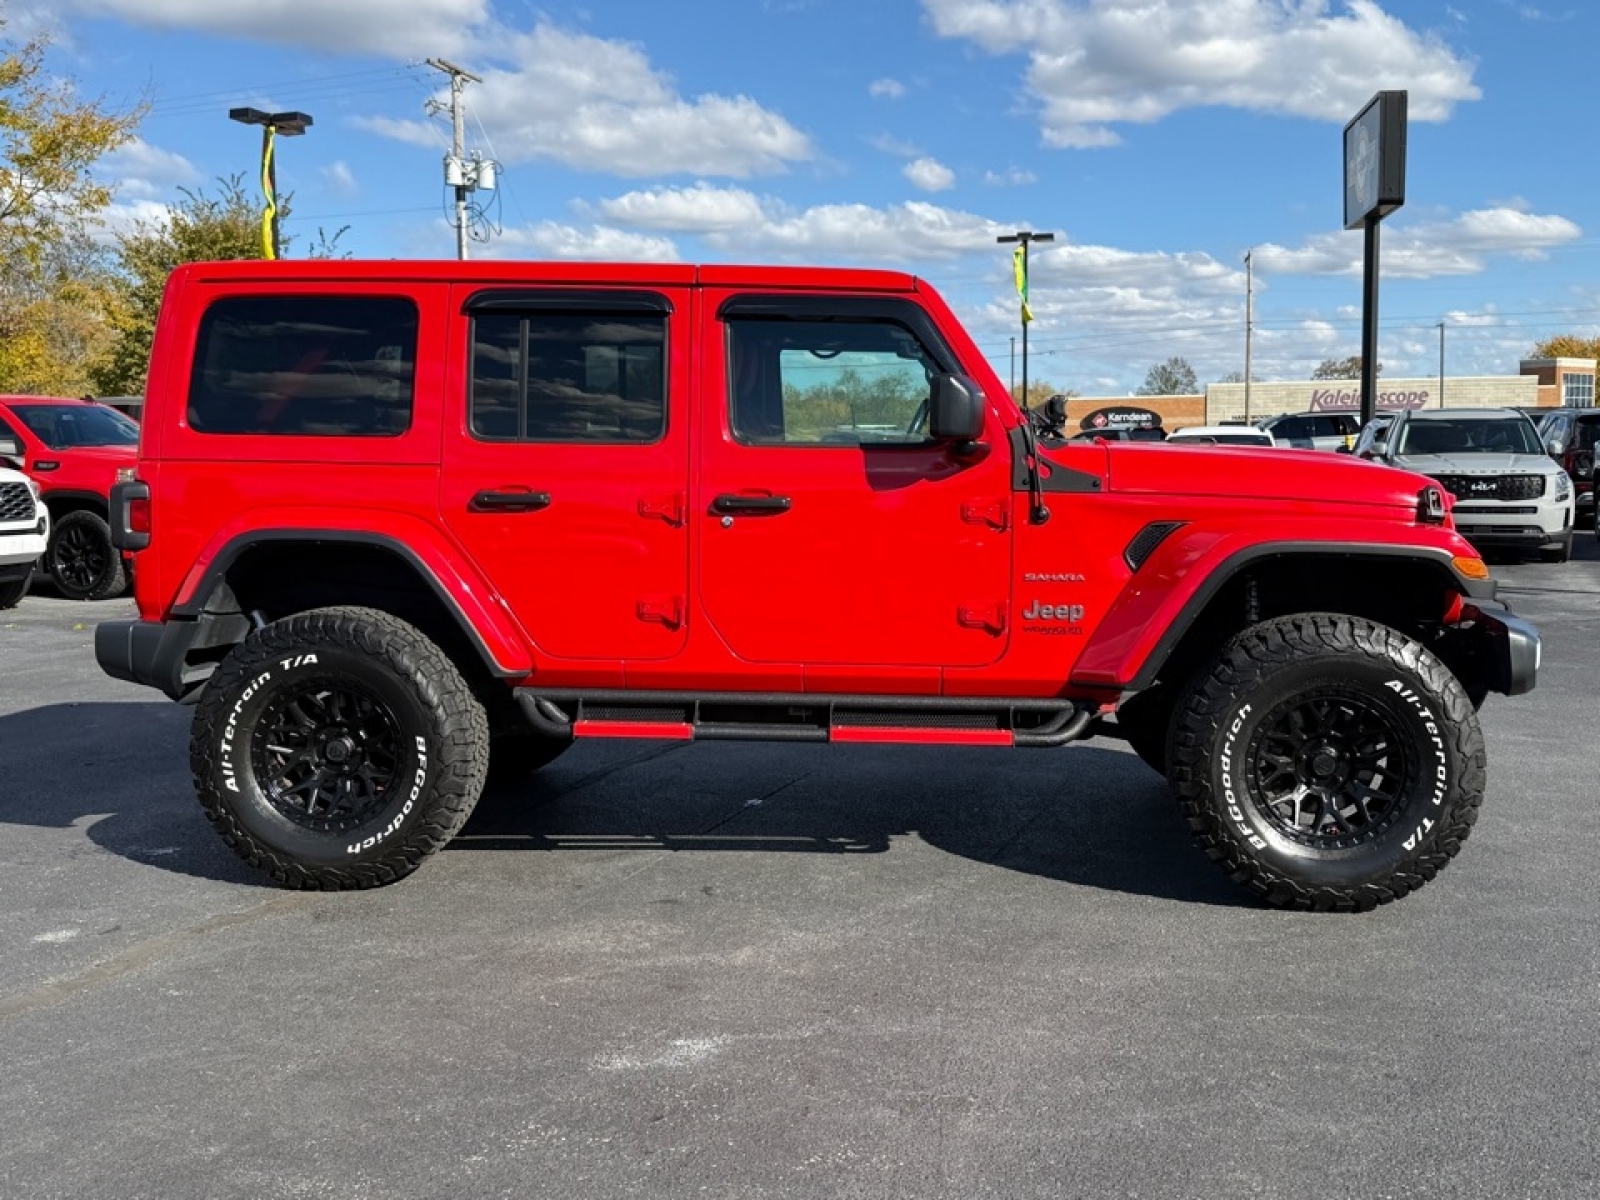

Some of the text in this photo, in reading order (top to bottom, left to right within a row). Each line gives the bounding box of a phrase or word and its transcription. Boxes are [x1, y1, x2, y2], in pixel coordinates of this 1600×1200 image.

[1107, 412, 1153, 422] Karndean
[1308, 389, 1429, 413] Kaleiscope
[1022, 599, 1085, 623] Jeep
[1024, 572, 1086, 581] SAHARA
[220, 653, 318, 792] All-Terrain T/A
[346, 735, 427, 854] BFGoodrich
[1220, 704, 1269, 850] BFGoodrich
[1384, 679, 1447, 851] All-Terrain T/A
